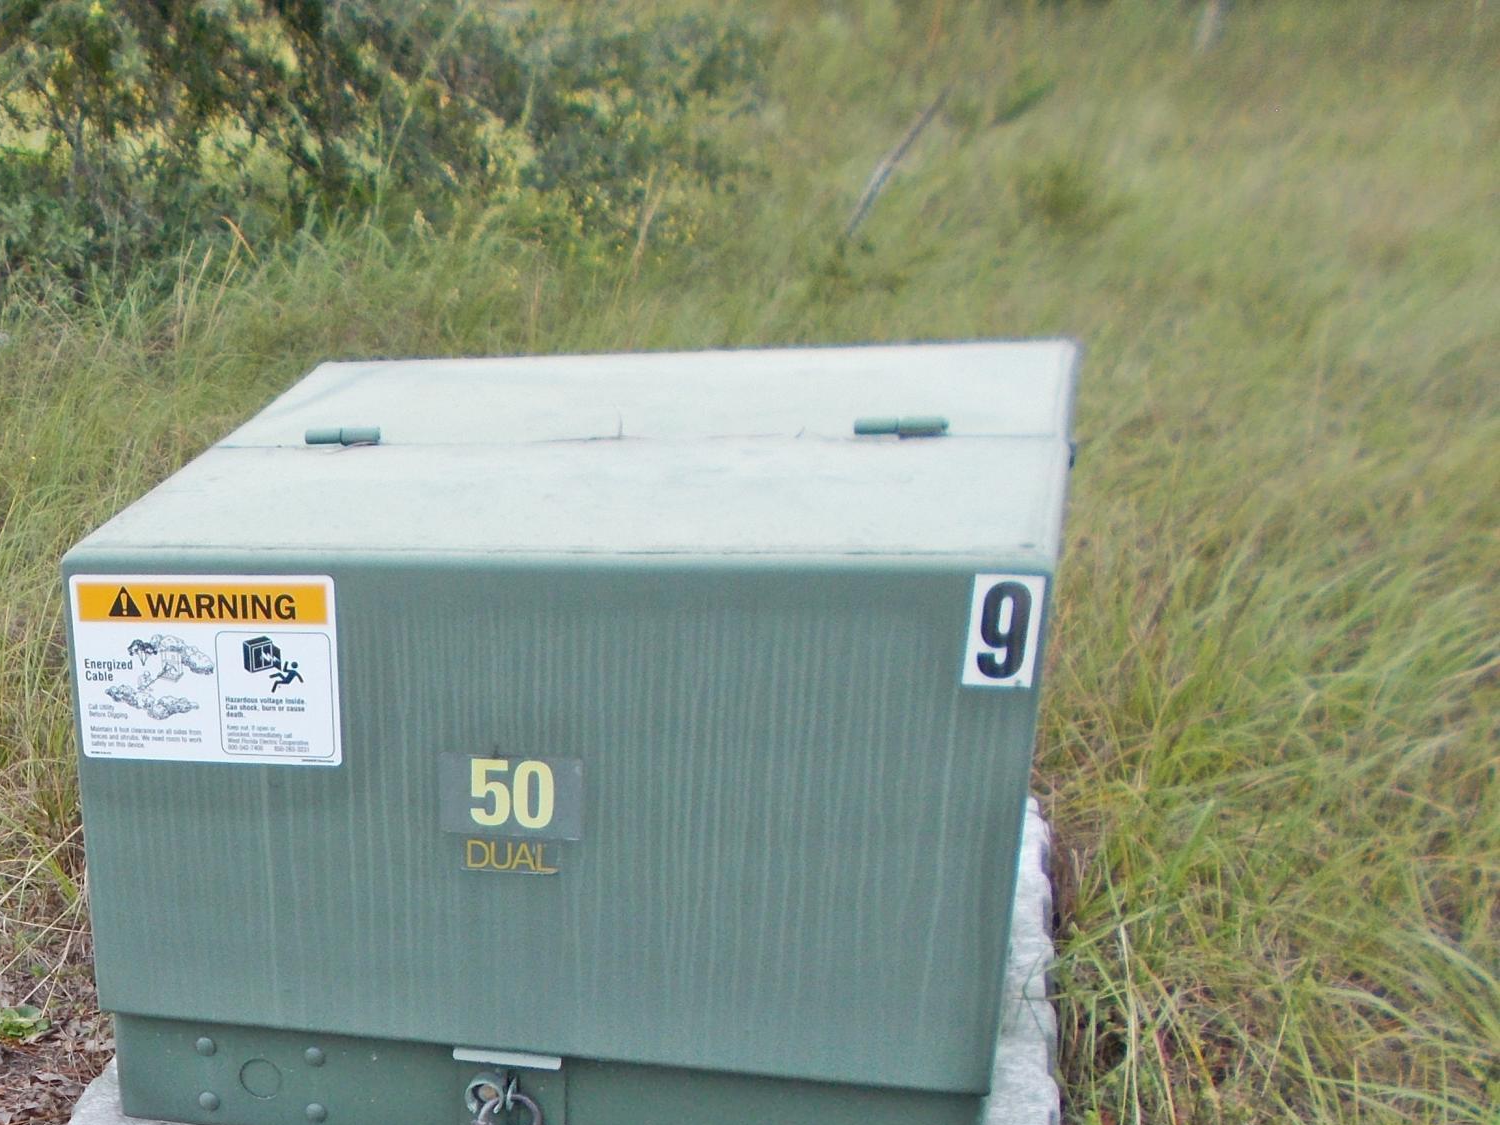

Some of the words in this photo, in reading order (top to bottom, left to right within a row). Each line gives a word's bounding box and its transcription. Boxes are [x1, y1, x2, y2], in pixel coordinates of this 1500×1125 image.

[145, 593, 296, 620] WARNING
[976, 581, 1033, 679] 9
[84, 658, 133, 671] Energized
[85, 670, 114, 681] Cable
[225, 696, 258, 704] Hazardous
[260, 697, 283, 705] voltage
[225, 703, 238, 711] Can
[470, 758, 555, 829] 50
[466, 839, 559, 875] DUAL
